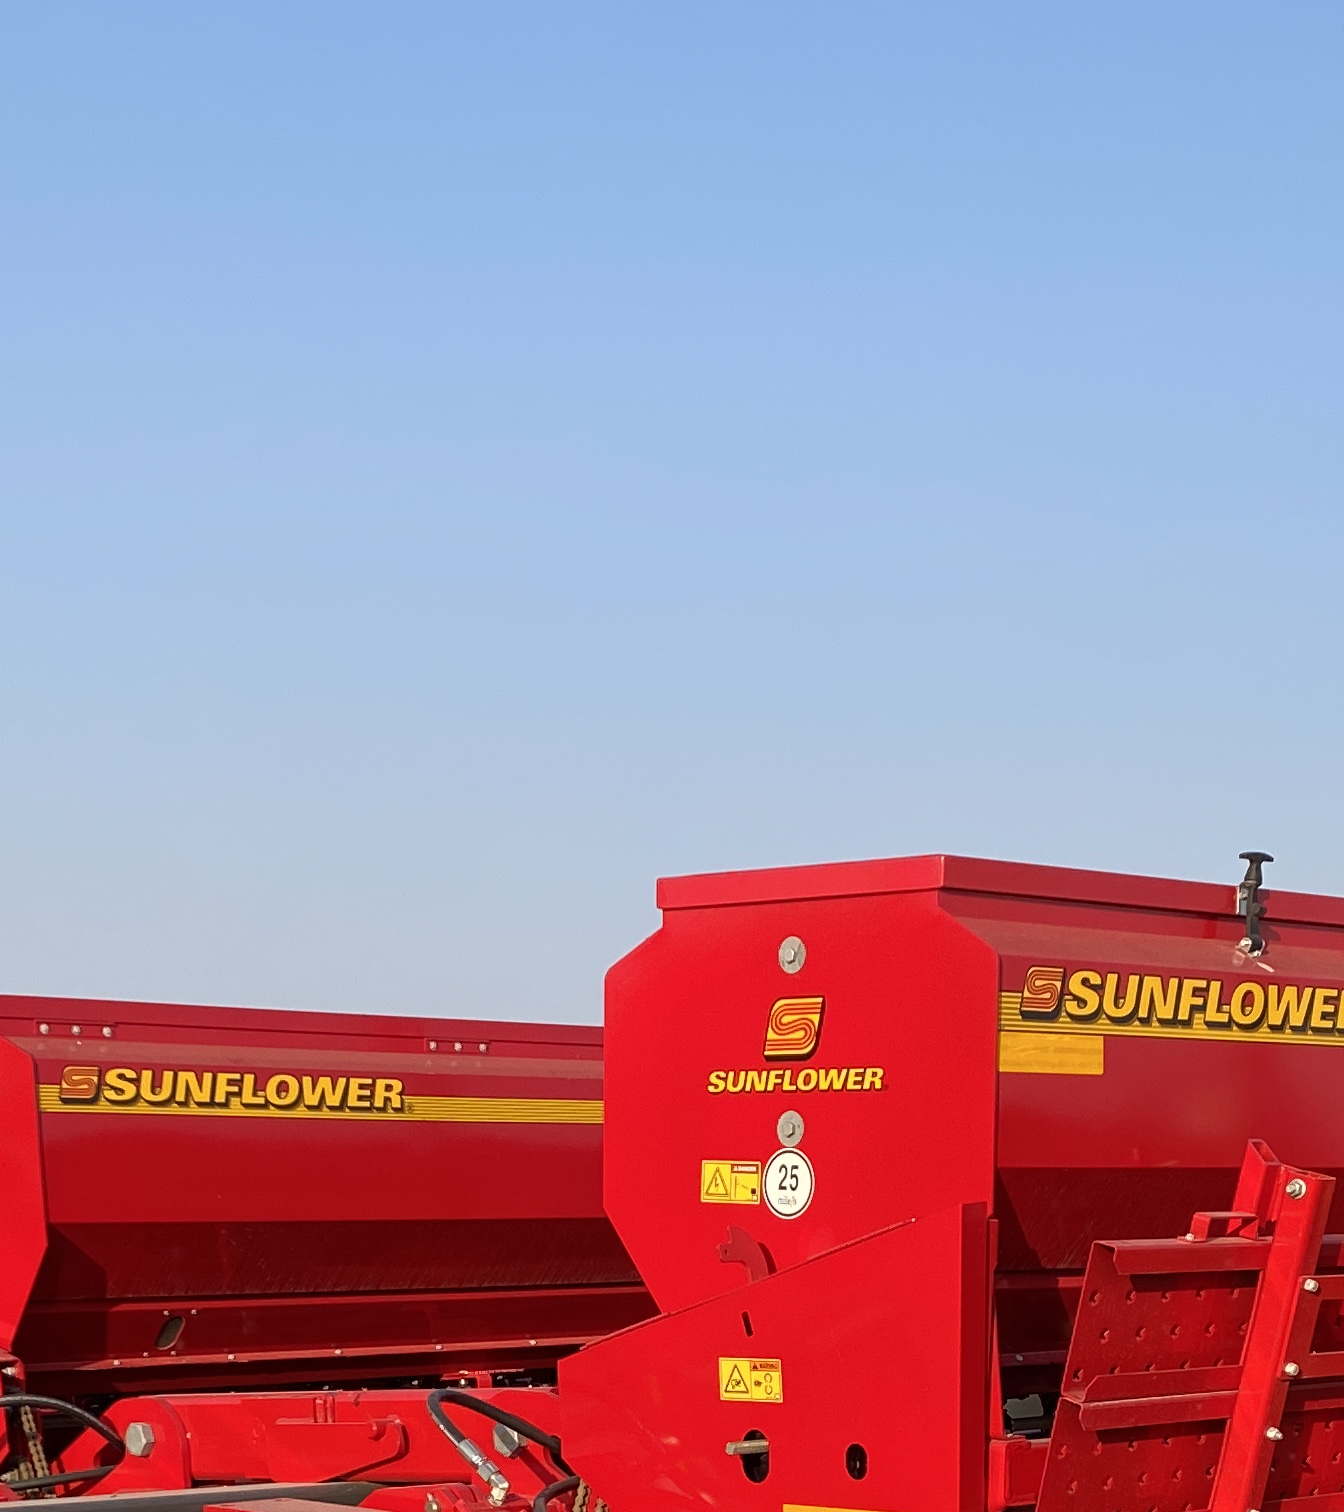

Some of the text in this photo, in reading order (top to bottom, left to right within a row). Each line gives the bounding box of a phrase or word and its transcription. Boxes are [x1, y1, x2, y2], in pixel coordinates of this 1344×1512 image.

[102, 1068, 404, 1112] SUNFLOWER
[707, 1067, 884, 1093] SUNFLOWER
[778, 1164, 799, 1191] 25
